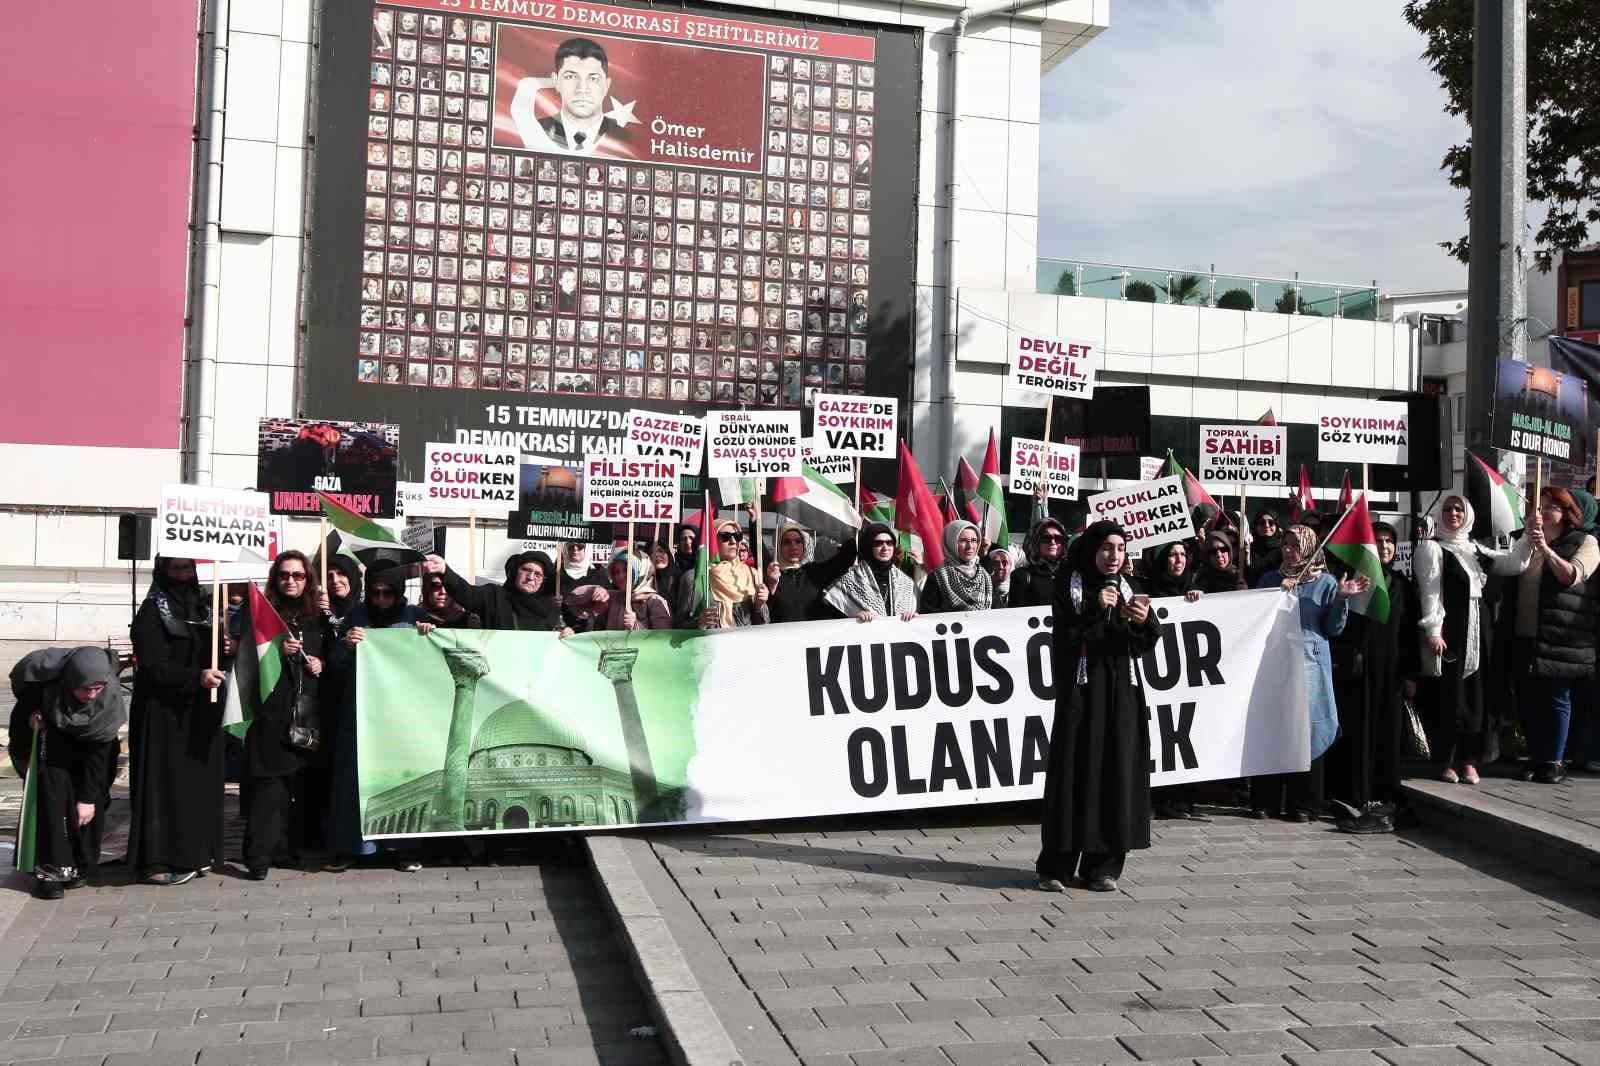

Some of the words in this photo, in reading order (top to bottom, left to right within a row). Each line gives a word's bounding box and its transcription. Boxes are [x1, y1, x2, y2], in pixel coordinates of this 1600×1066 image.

[470, 0, 557, 19] TEMMUZ
[563, 7, 680, 34] DEMOKRASİ
[685, 22, 820, 50] ŞEHİTLERİMİZ
[651, 115, 706, 139] Ömer
[650, 138, 755, 164] Halisdemir
[1019, 337, 1092, 359] DEVLET
[1018, 355, 1087, 381] DEĞİL,
[1017, 373, 1087, 393] TERÖRİST
[485, 404, 511, 424] 15
[720, 412, 752, 422] İSRAİL
[819, 400, 893, 415] GAZZE'DE
[633, 416, 702, 436] GAZZE'DE
[719, 422, 789, 434] DÜNYANIN
[818, 414, 893, 430] SOYKIRIM
[1320, 416, 1407, 432] SOYKIRIMA
[631, 429, 700, 449] SOYKIRIM
[713, 436, 745, 446] GÖZÜ
[748, 436, 796, 446] ÖNÜNDE
[825, 430, 884, 451] VAR!
[1206, 429, 1249, 438] TOPRAK
[1321, 429, 1350, 443] GÖZ
[1354, 432, 1407, 446] YUMMA
[713, 447, 757, 460] SAVAŞ
[760, 447, 796, 460] SUÇU
[1205, 434, 1281, 456] SAHİBİ
[1511, 429, 1520, 447] IS
[1522, 433, 1541, 452] OUR
[1542, 437, 1570, 460] HONOR
[431, 451, 516, 465] ÇOCUKLAR
[735, 459, 790, 476] İŞLİYOR
[1211, 455, 1244, 466] EVİNE
[1247, 455, 1275, 467] GERİ
[430, 467, 515, 485] ÖLÜRKEN
[590, 458, 675, 478] FİLİSTİN
[1020, 468, 1048, 480] EVİN
[1203, 466, 1282, 482] DÖNÜYOR
[314, 476, 342, 491] GAZA
[621, 480, 674, 488] OLMADIKÇA
[274, 491, 320, 512] UNDER
[429, 486, 515, 501] SUSULMAZ
[1095, 484, 1178, 515] ÇOCUKLAR
[590, 499, 673, 519] DEĞİLİZ
[165, 513, 266, 532] OLANLARA
[165, 527, 265, 547] SUSMAYIN
[805, 621, 1015, 716] KUDÜS
